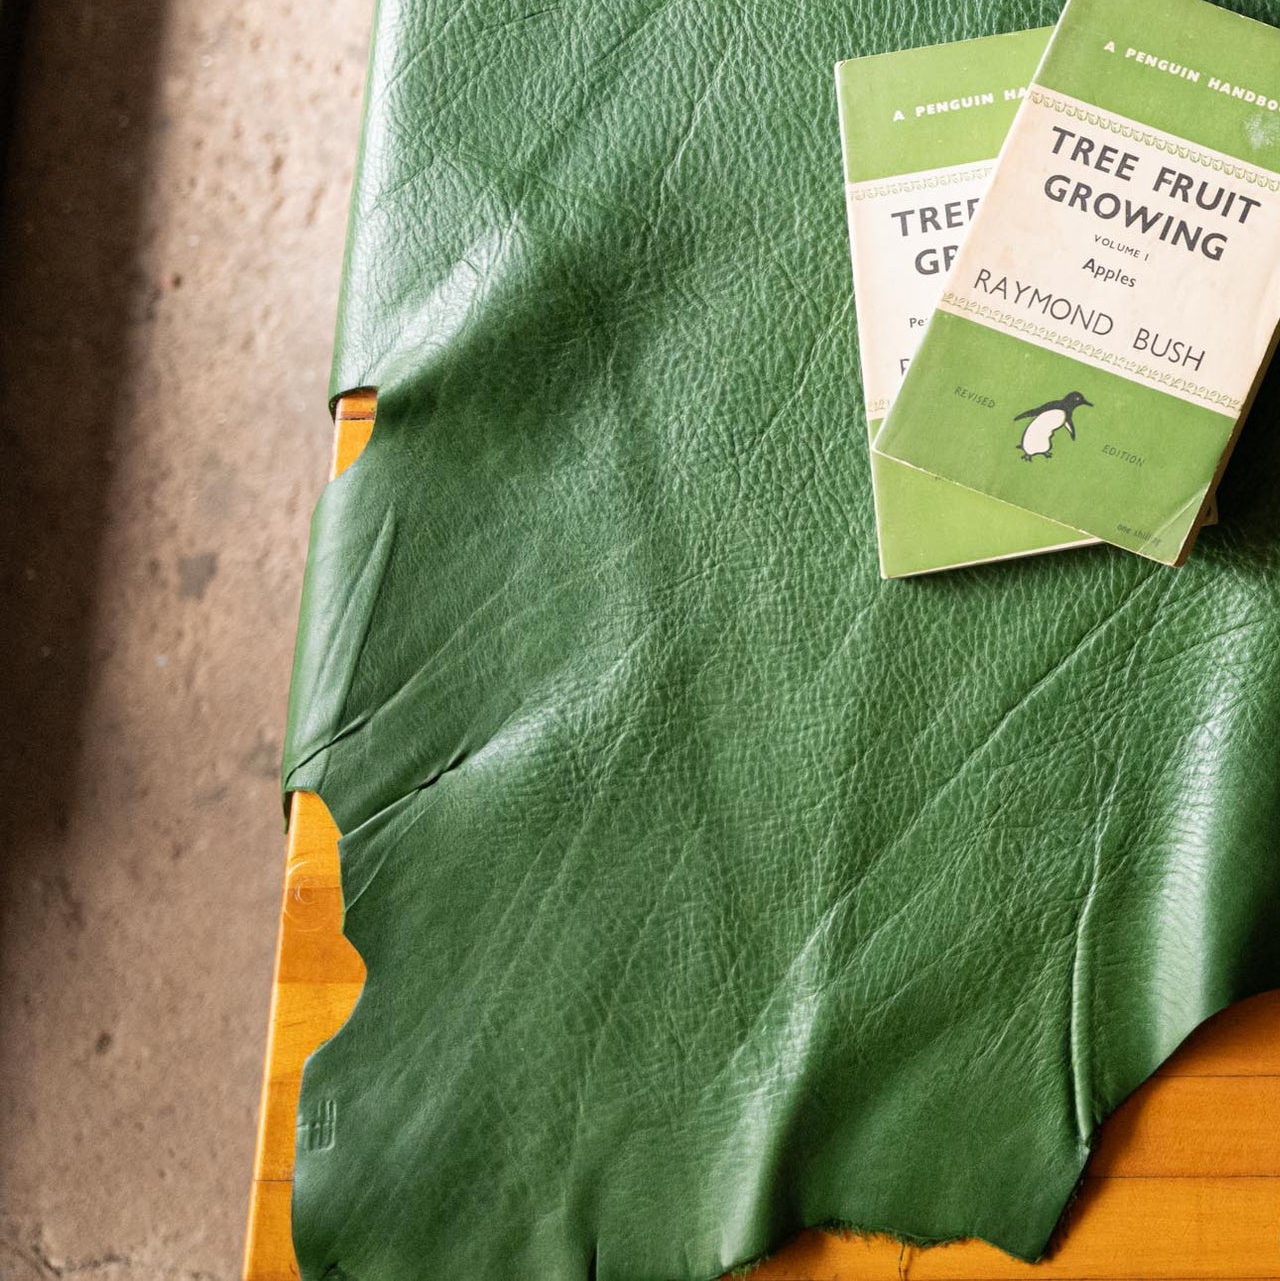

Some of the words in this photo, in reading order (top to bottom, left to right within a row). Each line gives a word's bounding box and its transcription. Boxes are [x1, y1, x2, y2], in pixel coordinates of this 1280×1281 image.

[1104, 40, 1116, 53] A
[1125, 47, 1201, 83] PENGUIN
[893, 110, 905, 122] A
[915, 93, 994, 117] PENGUIN
[1051, 125, 1140, 181] TREE
[1152, 166, 1261, 224] FRUIT
[1044, 174, 1228, 261] GROWING
[1094, 234, 1141, 261] VOLUME
[1081, 257, 1137, 288] Apples
[973, 268, 1114, 336] RAYMOND
[1132, 328, 1206, 372] BUSH
[954, 386, 996, 409] REVISED
[1102, 444, 1145, 467] EDITION
